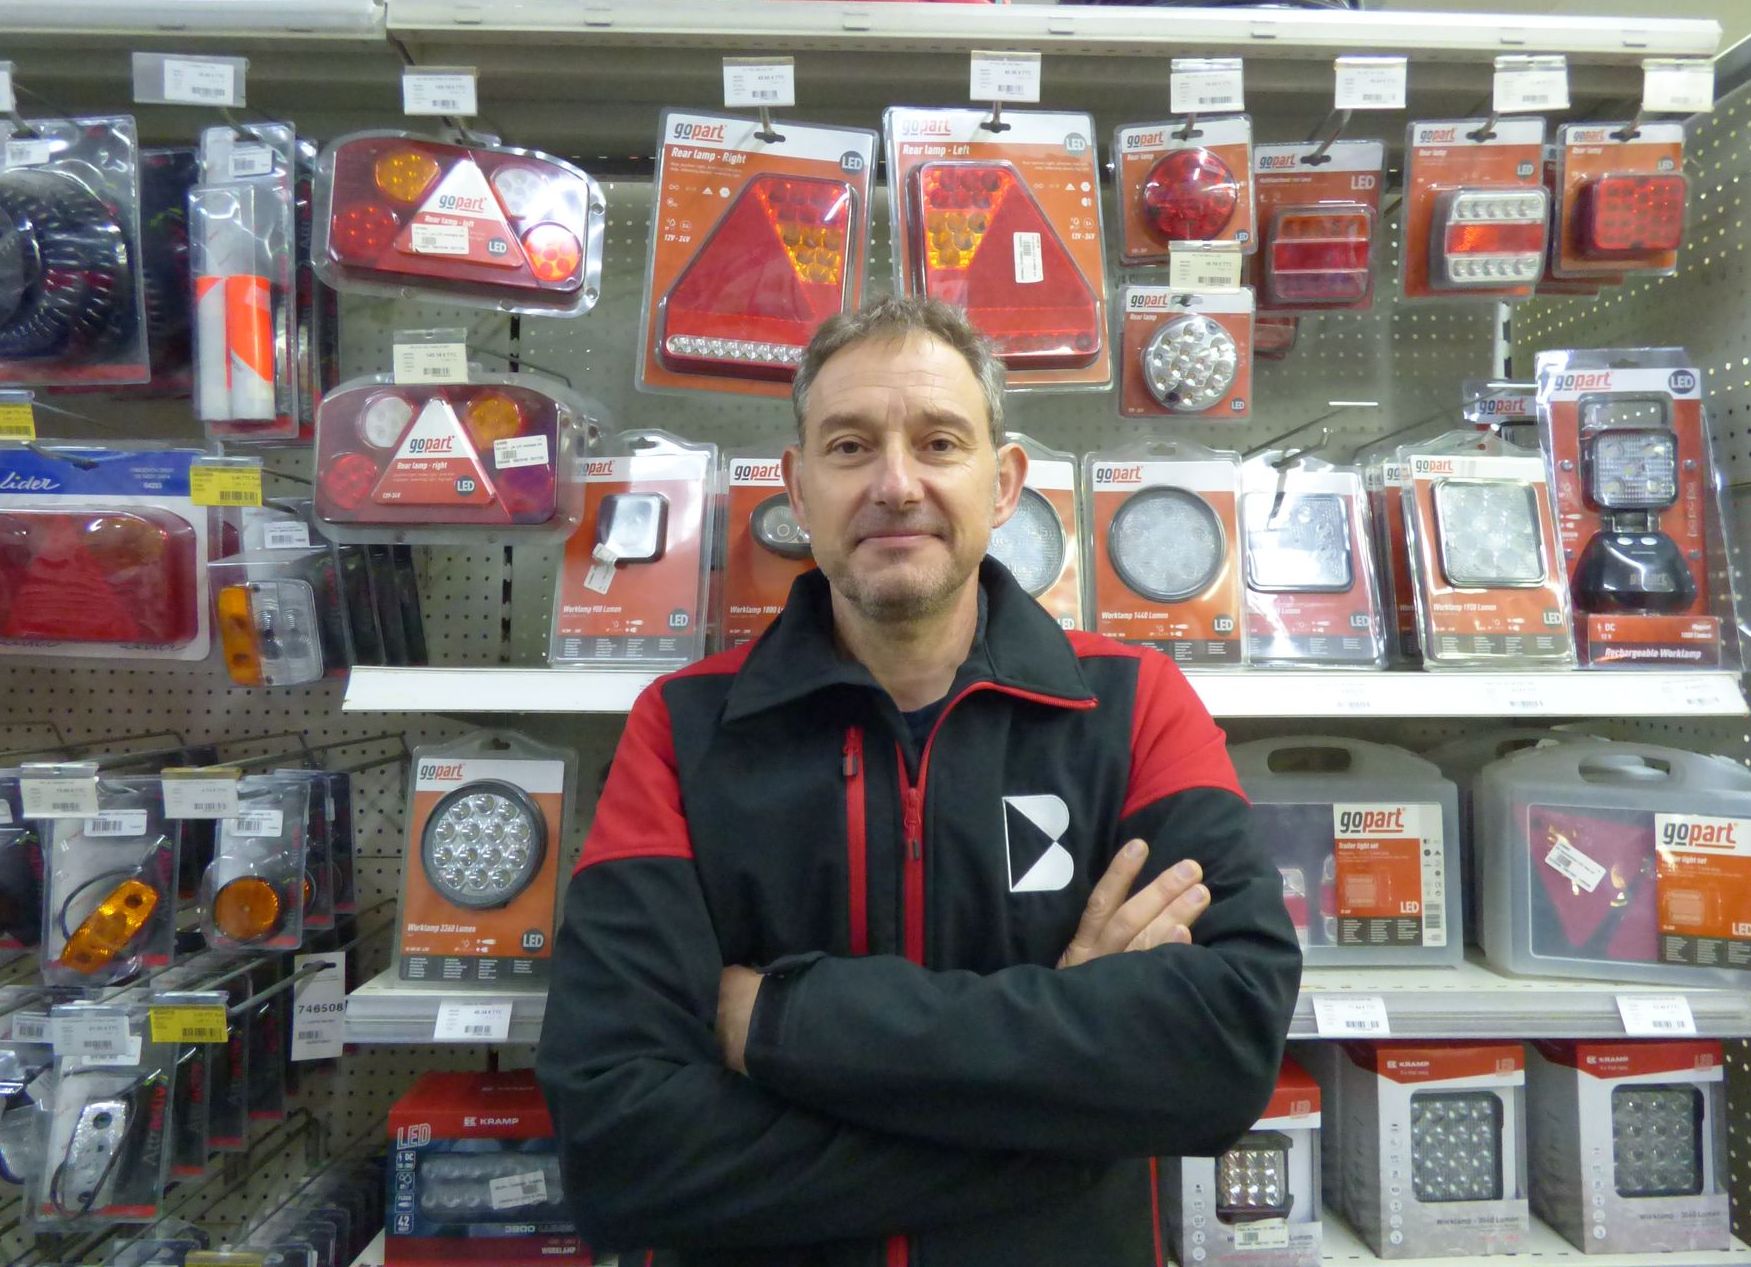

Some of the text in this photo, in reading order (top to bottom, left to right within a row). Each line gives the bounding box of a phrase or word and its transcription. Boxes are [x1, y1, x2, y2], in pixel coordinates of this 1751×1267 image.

[674, 122, 724, 142] gopart
[902, 118, 951, 136] gopart
[1127, 131, 1164, 148] gopart
[1420, 127, 1456, 143] gopart
[1573, 129, 1605, 142] gopart
[902, 144, 922, 156] Rear
[924, 143, 945, 157] lamp
[953, 145, 970, 155] Left
[1065, 137, 1086, 151] LED
[671, 147, 691, 159] Rear
[693, 149, 715, 162] lamp
[722, 151, 746, 165] Right
[841, 156, 862, 169] LED
[1260, 153, 1295, 169] gopart
[1518, 164, 1533, 175] LED
[1658, 160, 1674, 171] LED
[1351, 176, 1375, 190] LED
[439, 194, 485, 211] gopart
[1236, 232, 1248, 242] LED
[488, 240, 507, 253] LED
[1131, 294, 1169, 308] gopart
[1554, 371, 1611, 391] gopart
[1671, 376, 1693, 387] LED
[1232, 400, 1244, 409] LED
[1478, 399, 1526, 416] gopart
[409, 436, 453, 453] gopart
[734, 464, 781, 481] gopart
[1415, 460, 1453, 473] gopart
[1096, 466, 1142, 483] gopart
[457, 480, 475, 491] LED
[729, 605, 762, 616] Worklamp
[1101, 611, 1133, 622] Worklamp
[1148, 611, 1169, 620] Lumen
[669, 614, 689, 627] LED
[1057, 618, 1075, 630] ED
[1214, 619, 1233, 631] LED
[1350, 615, 1370, 627] LED
[1543, 612, 1562, 625] LED
[1604, 623, 1616, 631] DC
[1604, 647, 1702, 660] Rechargeable Worklamp
[419, 763, 464, 781] gopart
[1340, 807, 1404, 833] gopart
[1663, 822, 1737, 849] gopart
[1356, 842, 1369, 850] light
[1400, 901, 1419, 913] LED
[407, 923, 439, 934] Worklamp
[523, 934, 544, 948] LED
[298, 1002, 345, 1015] 746508
[1399, 1060, 1430, 1068] KRAMP
[1290, 1101, 1311, 1118] LED
[480, 1117, 519, 1126] KRAMP
[396, 1123, 432, 1150] LED
[398, 1216, 409, 1226] 42
